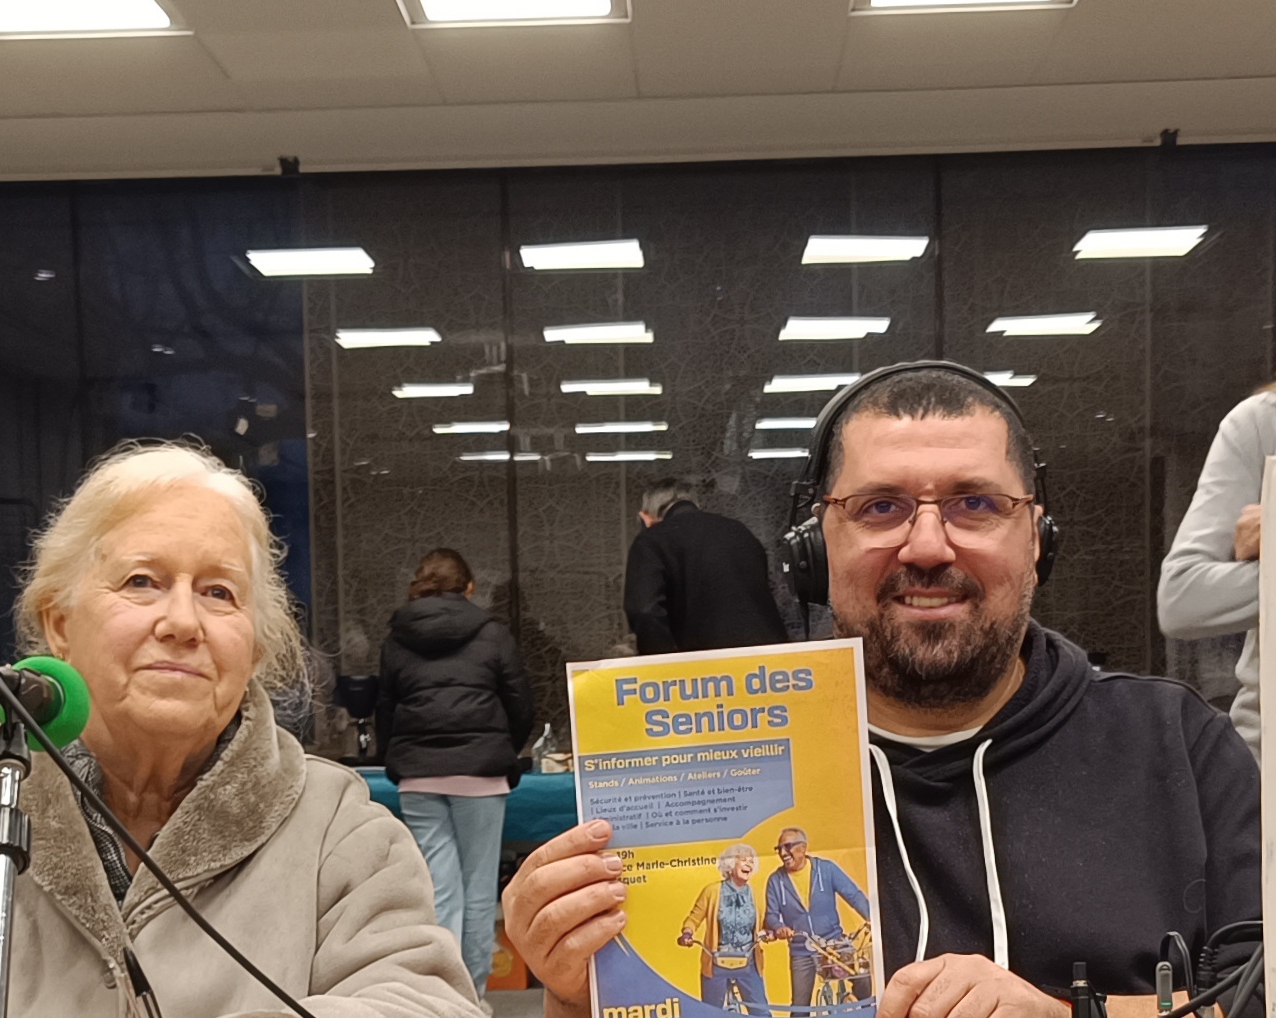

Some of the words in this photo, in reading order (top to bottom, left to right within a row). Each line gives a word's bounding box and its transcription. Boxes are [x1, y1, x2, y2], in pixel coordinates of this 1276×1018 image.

[614, 674, 734, 706] Forum
[744, 665, 814, 695] des
[644, 703, 789, 738] Seniors
[584, 756, 658, 771] S'informer
[662, 753, 694, 767] pour
[697, 749, 738, 762] mieux
[741, 743, 785, 758] vieillir
[588, 780, 619, 789] Stands
[628, 774, 678, 785] Animations
[687, 770, 721, 781] Ateliers
[730, 767, 761, 777] Goûter
[634, 792, 677, 803] prévention
[683, 788, 705, 797] Santé
[707, 787, 715, 795] et
[618, 803, 654, 812] d'accueil
[664, 796, 736, 808] Accompagnement
[674, 808, 711, 816] comment
[644, 820, 676, 829] Service
[691, 816, 728, 825] personne
[636, 856, 717, 871] Marie-Christine
